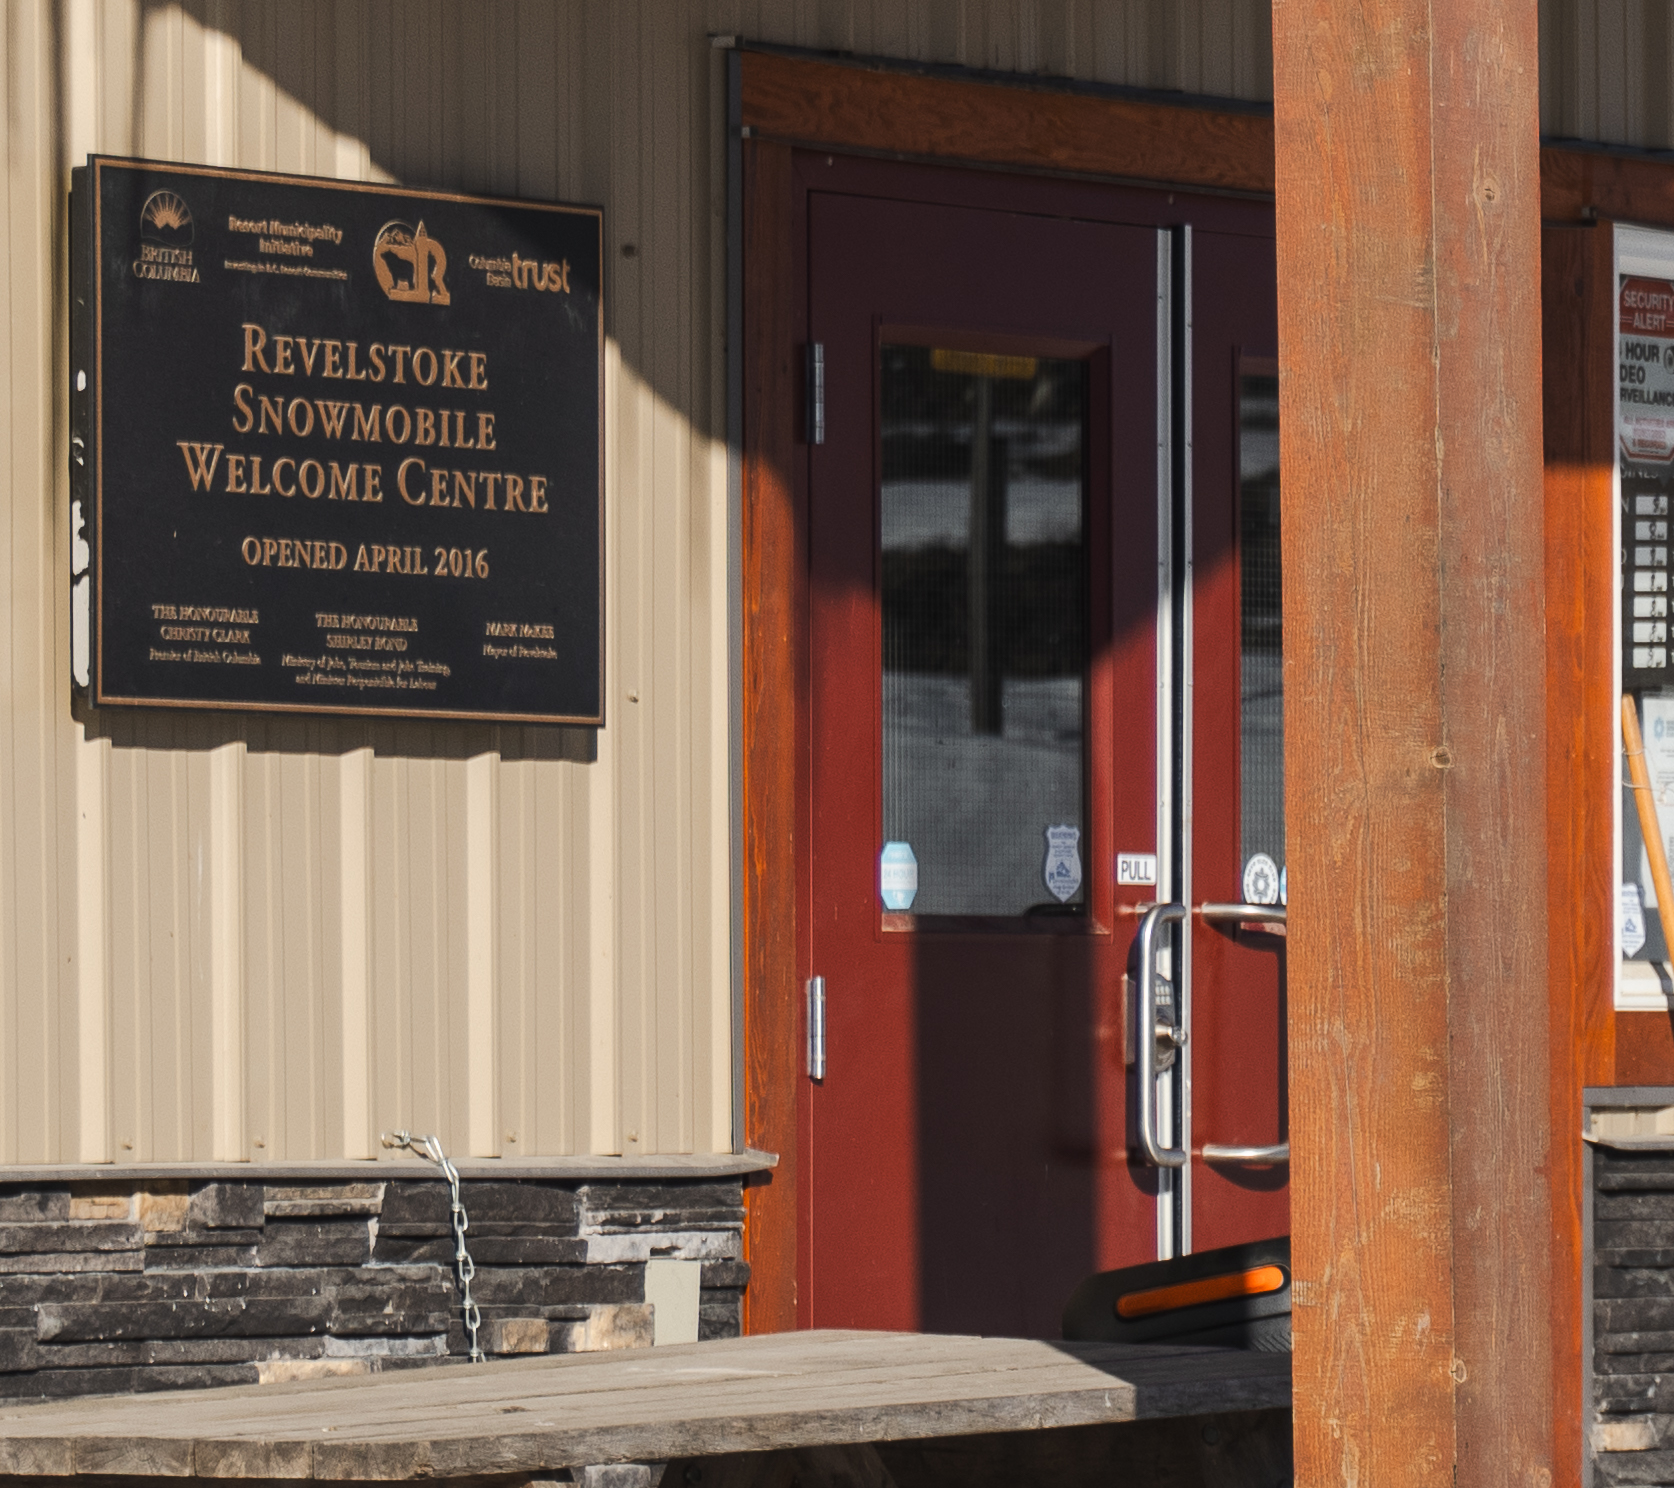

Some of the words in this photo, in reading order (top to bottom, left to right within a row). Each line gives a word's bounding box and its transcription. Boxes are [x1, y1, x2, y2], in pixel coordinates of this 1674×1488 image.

[228, 215, 268, 235] Resort
[269, 219, 343, 245] Municipality
[141, 245, 193, 265] BRITISH
[259, 238, 314, 257] Initiative
[132, 261, 200, 283] COLUMBIA
[469, 253, 511, 272] Columbia
[512, 250, 571, 293] trust
[486, 272, 512, 287] Basin
[1623, 290, 1674, 312] SECURITY
[1633, 313, 1667, 331] ALERT
[241, 322, 489, 391] REVELSTOKE
[1625, 342, 1660, 363] HOUR
[1619, 366, 1646, 385] DEO
[232, 382, 497, 450] SNOWMOBILE
[176, 440, 383, 502] WELCOME
[397, 456, 550, 514] CENTRE
[241, 536, 348, 572] OPENED
[353, 544, 428, 576] APRIL
[434, 547, 490, 580] 2016
[152, 604, 178, 620] THE
[179, 606, 259, 624] HONOURABLE
[315, 612, 340, 628] THE
[341, 614, 418, 631] HONOURABLE
[160, 625, 211, 642] CHRISTY
[212, 628, 251, 643] CLARK
[485, 620, 518, 637] MARK
[326, 633, 374, 649] SHIRLEY
[375, 636, 408, 651] BOND
[1121, 860, 1152, 882] PULL
